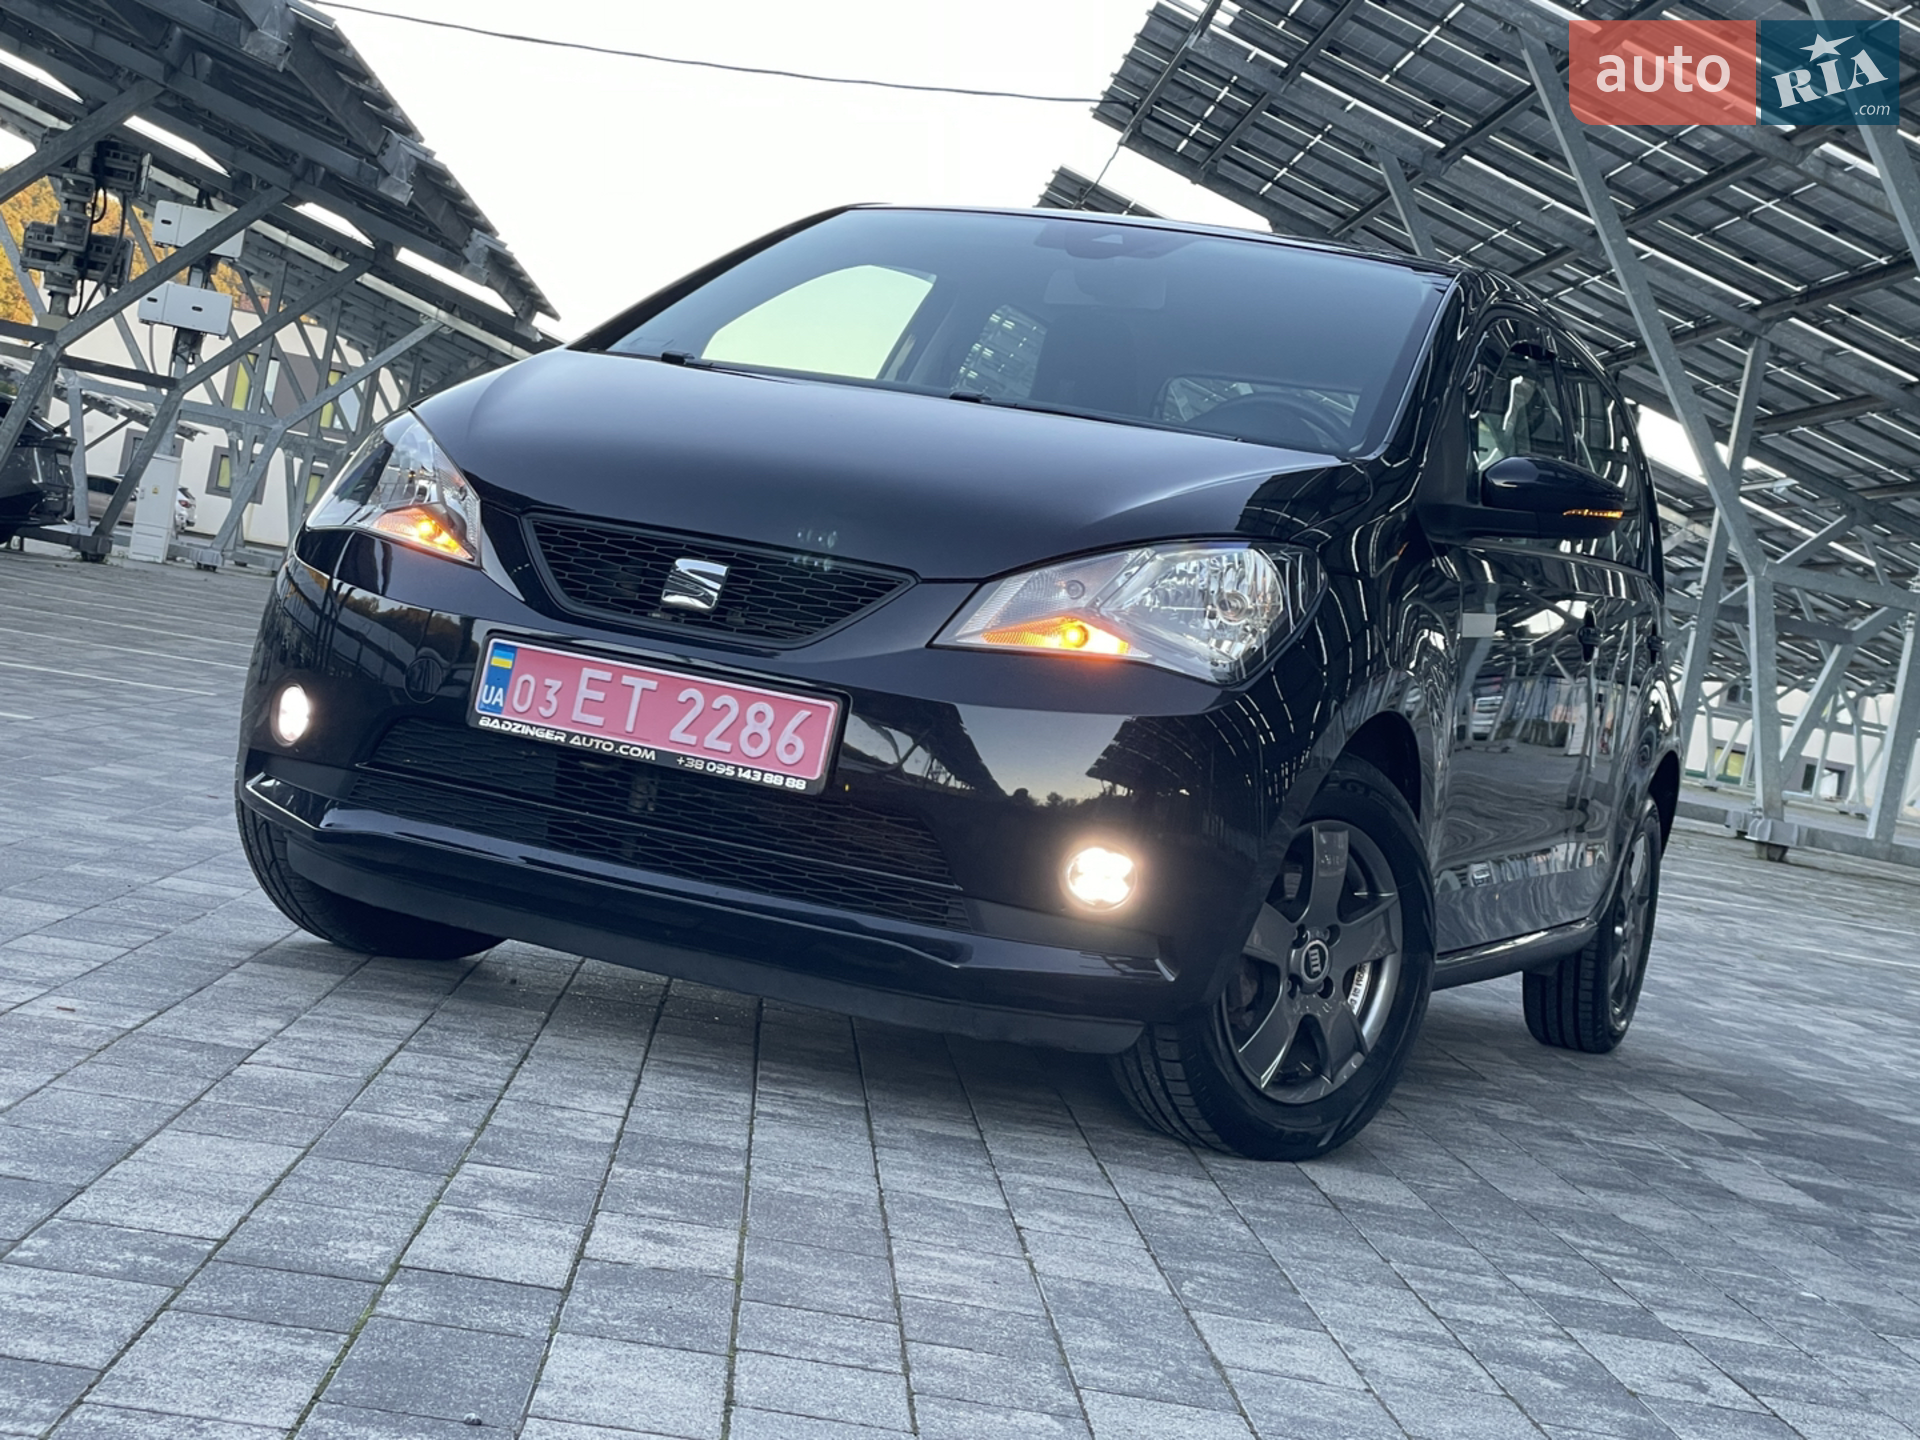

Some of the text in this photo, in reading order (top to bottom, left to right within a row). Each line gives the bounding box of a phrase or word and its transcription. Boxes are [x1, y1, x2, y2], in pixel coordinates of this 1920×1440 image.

[481, 684, 505, 708] UA
[478, 716, 567, 743] BADZINGER
[511, 666, 813, 766] 03 ET 2286
[676, 756, 807, 790] +38 095 143 88 88
